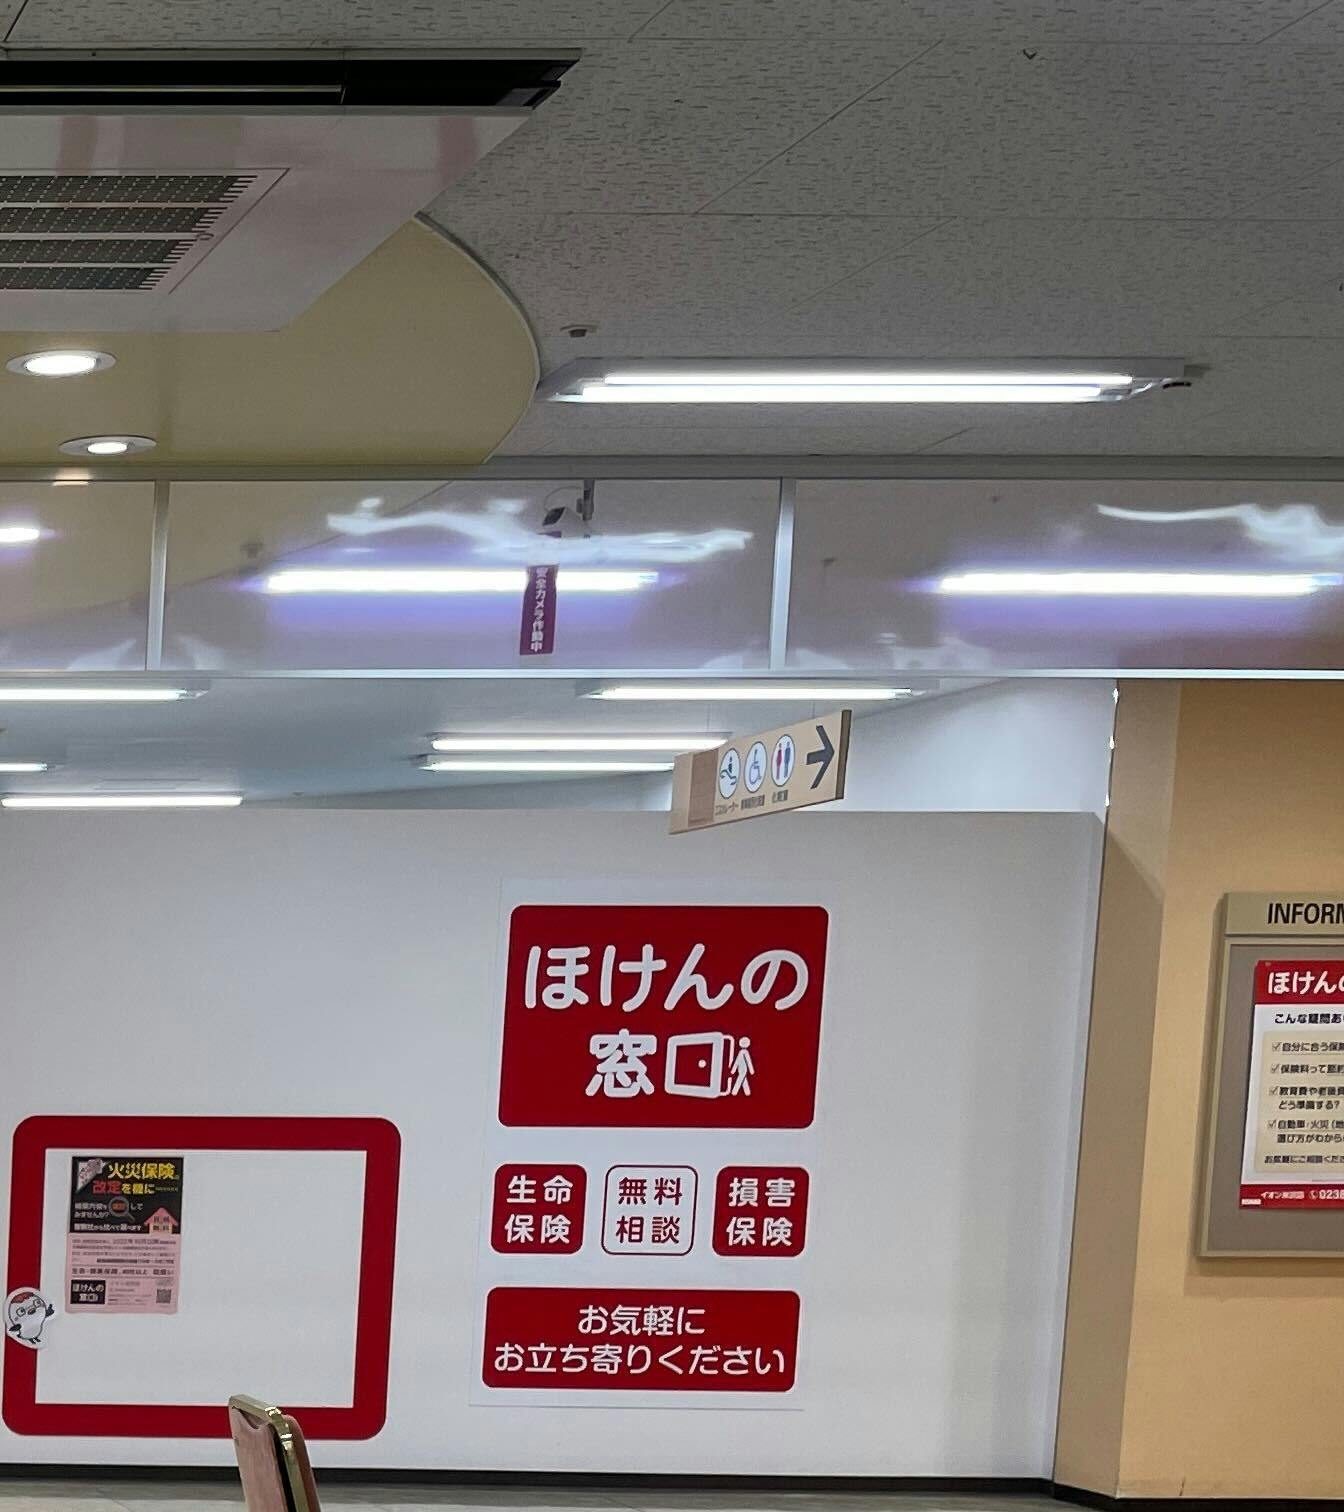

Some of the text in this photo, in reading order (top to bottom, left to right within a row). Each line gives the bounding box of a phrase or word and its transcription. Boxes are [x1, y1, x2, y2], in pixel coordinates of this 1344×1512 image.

[523, 942, 811, 1013] ほけんの
[1267, 970, 1344, 995] ほけん
[1274, 1013, 1344, 1025] こんな疑問あ
[1276, 1133, 1344, 1144] 選び方がわから
[505, 1174, 574, 1205] 生命
[617, 1176, 683, 1206] 無料
[728, 1177, 796, 1208] 損害
[504, 1214, 572, 1245] 保険
[615, 1215, 681, 1245] 相談
[725, 1216, 794, 1248] 保険
[577, 1303, 706, 1337] お気軽に
[494, 1342, 786, 1376] お立ち寄りください
